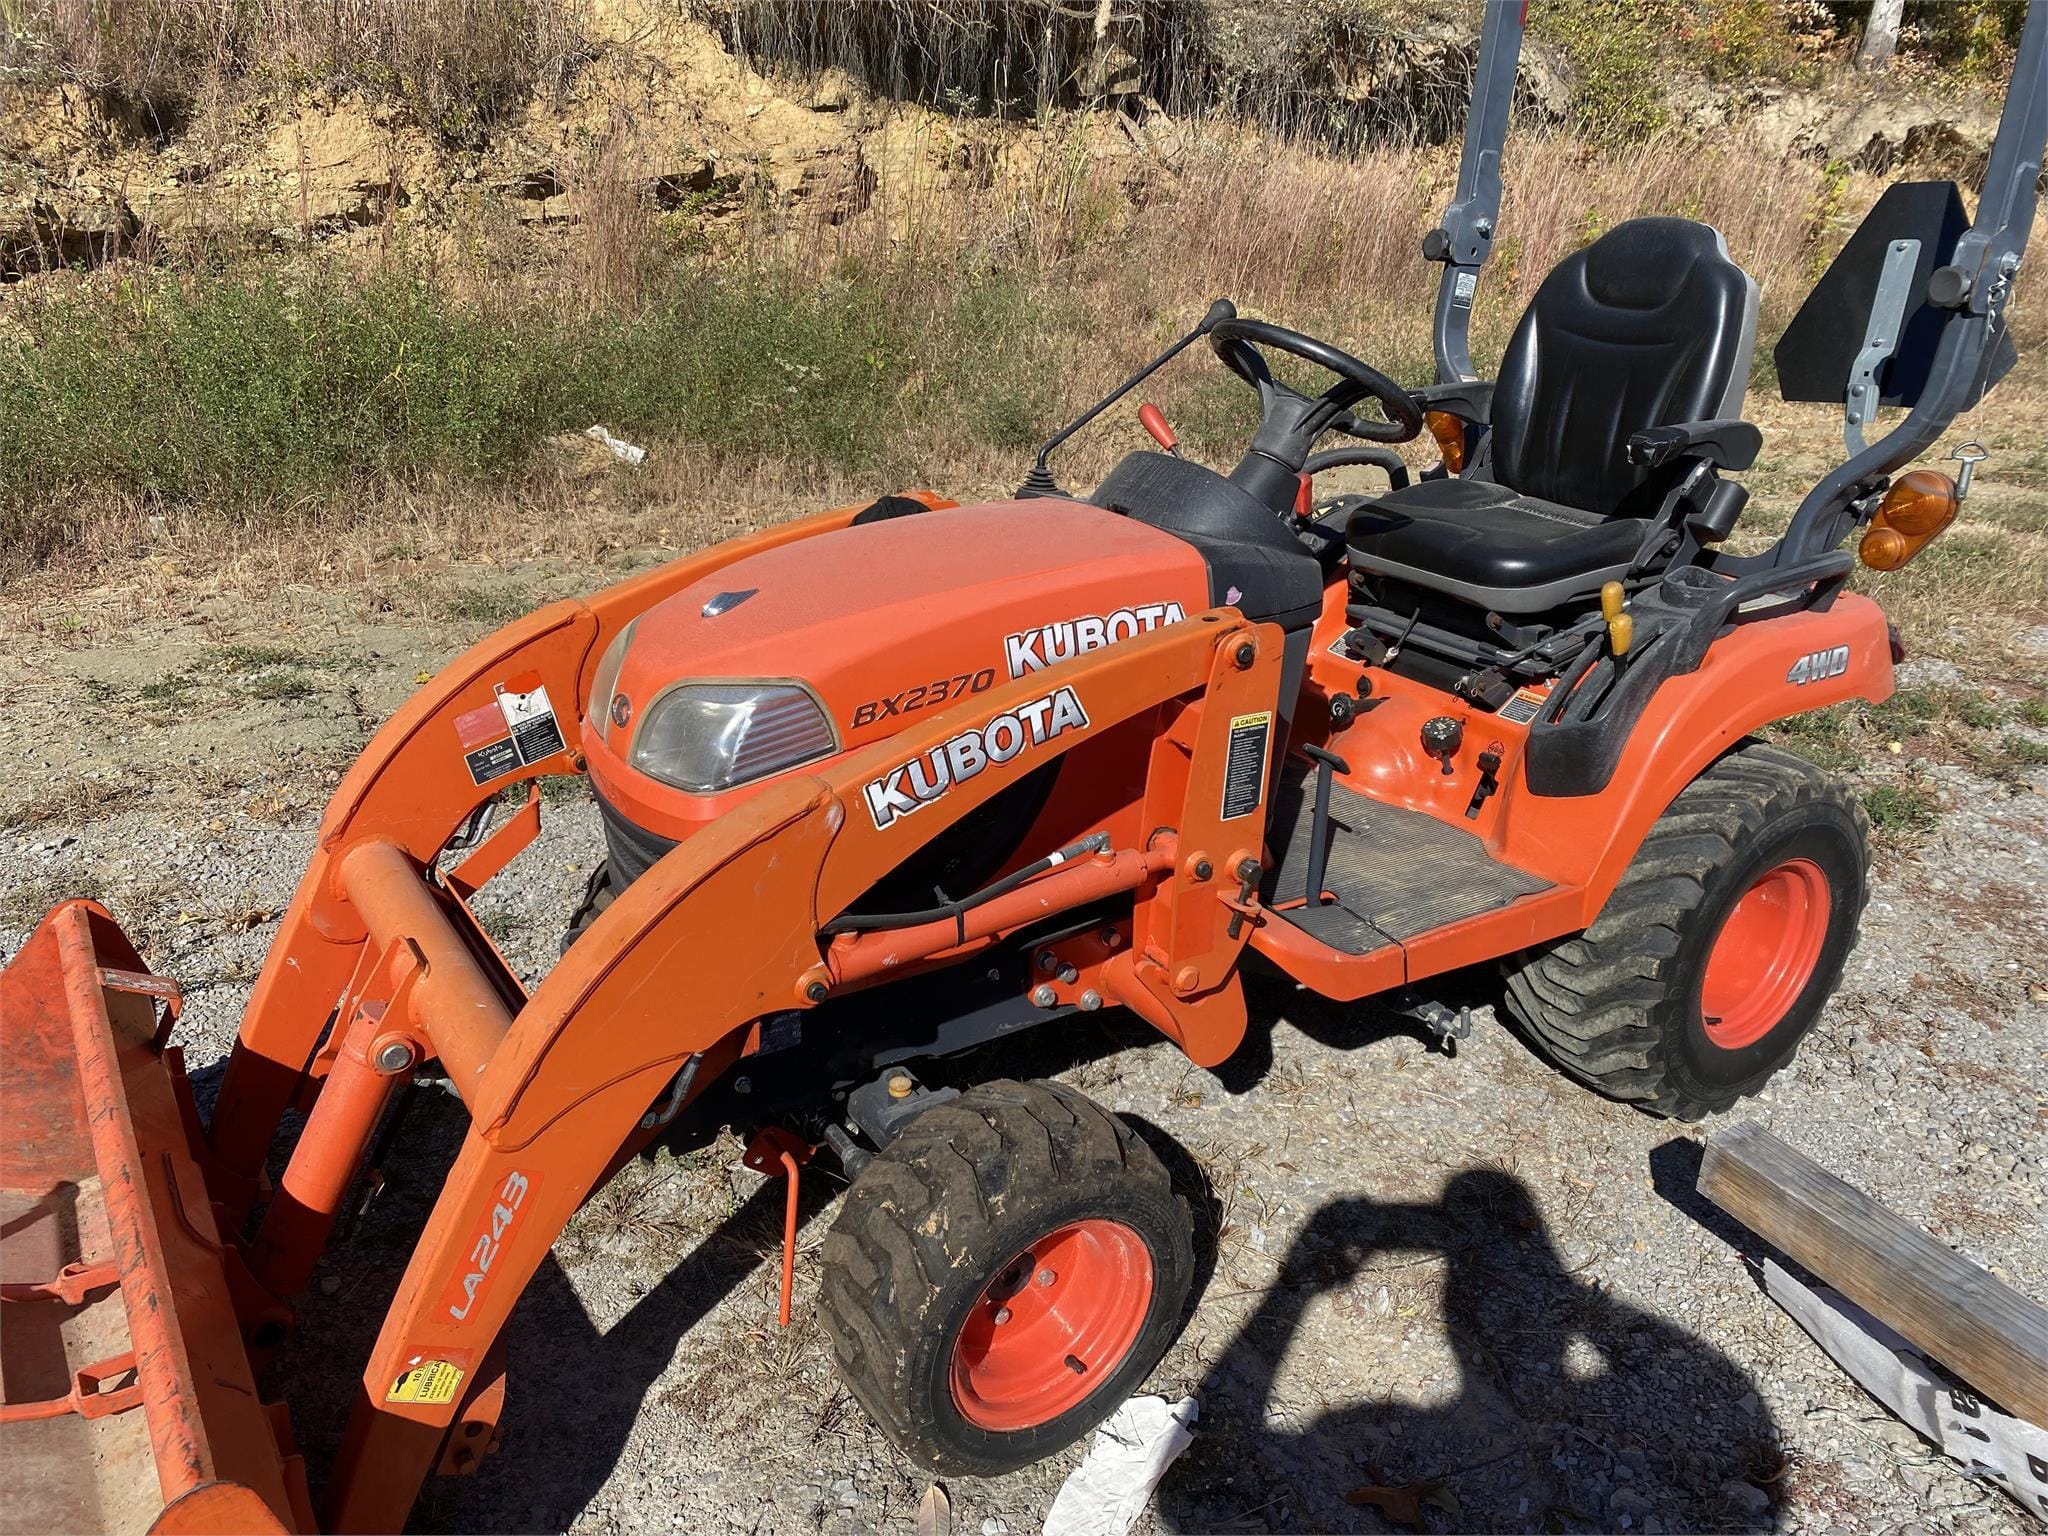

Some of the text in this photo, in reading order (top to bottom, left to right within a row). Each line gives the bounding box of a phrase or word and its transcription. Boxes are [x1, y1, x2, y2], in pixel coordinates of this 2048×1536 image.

[1786, 644, 1849, 686] 4WD
[851, 668, 996, 729] BX2370
[1240, 715, 1267, 726] CAUTION
[864, 686, 1088, 828] KUBOTA
[449, 1170, 528, 1320] LA243
[420, 1360, 441, 1398] LUBRICA
